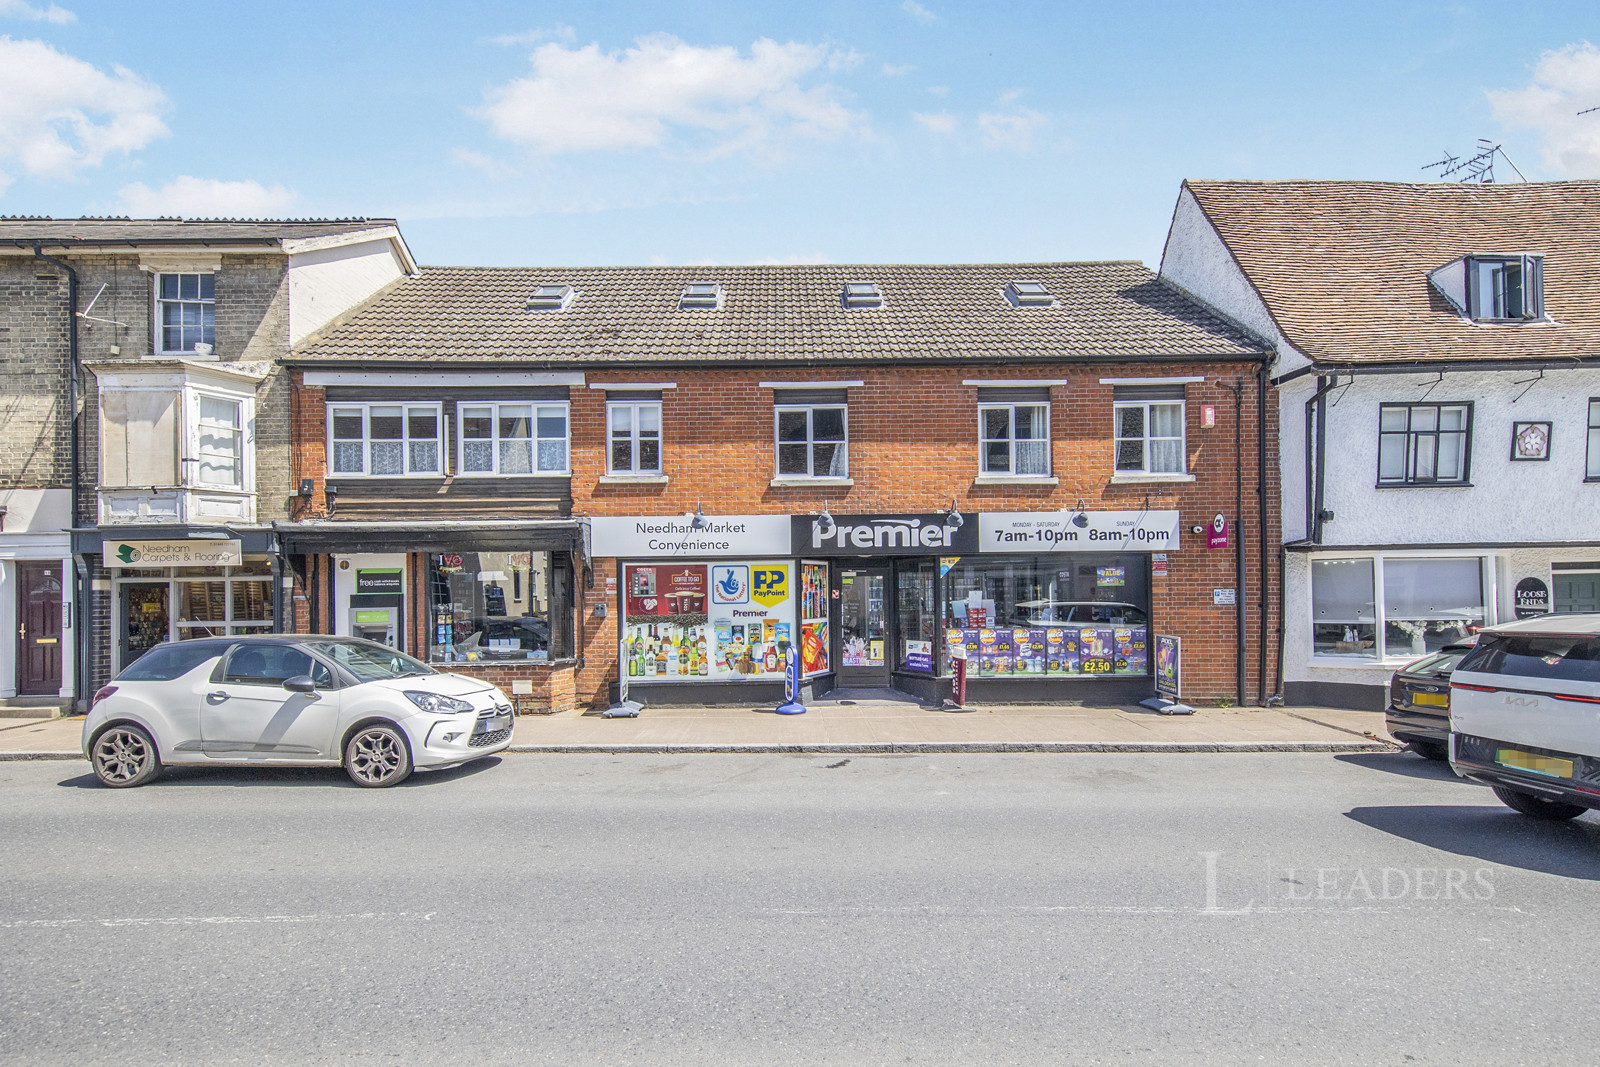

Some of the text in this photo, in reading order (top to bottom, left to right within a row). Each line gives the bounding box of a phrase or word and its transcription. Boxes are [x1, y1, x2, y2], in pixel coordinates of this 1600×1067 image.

[636, 521, 746, 534] Needham Market
[812, 518, 958, 548] Premier
[995, 528, 1079, 543] 7am-10pm
[1088, 527, 1170, 542] 8am-10pm
[142, 545, 190, 553] Needham
[648, 539, 730, 550] Convenience
[142, 552, 230, 563] Carpets & Flooring
[1517, 590, 1547, 598] LOOSE
[733, 609, 768, 617] Premier
[1084, 661, 1110, 671] £2.50
